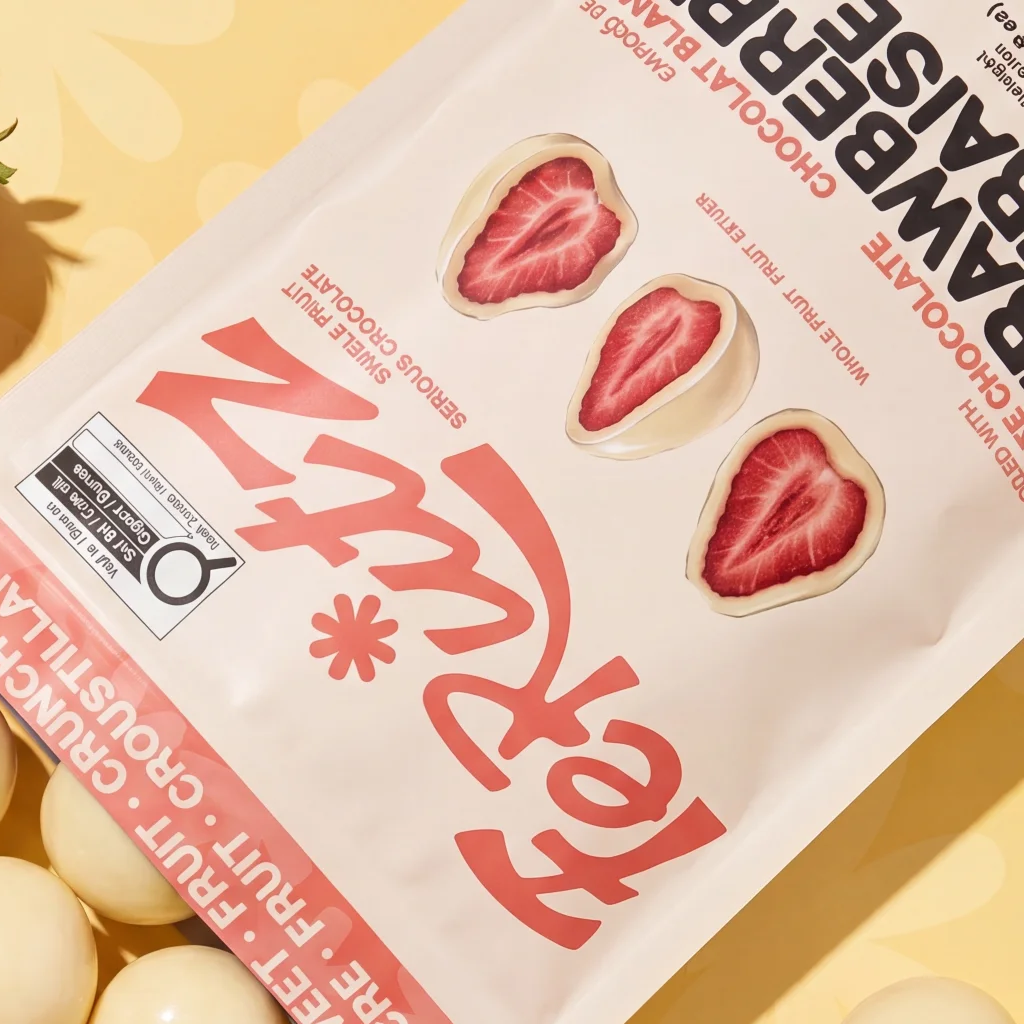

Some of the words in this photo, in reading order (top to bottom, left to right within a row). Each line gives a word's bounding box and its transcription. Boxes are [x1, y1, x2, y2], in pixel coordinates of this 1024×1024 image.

[691, 58, 837, 199] CHOCOLAT
[813, 0, 1024, 262] RAISE
[669, 0, 1024, 390] RAWBERR
[301, 263, 398, 356] CROCOLATE
[819, 327, 870, 386] WHOLE
[861, 231, 1011, 410] CHOCOLATE
[395, 353, 467, 430] SERIOUS
[958, 399, 999, 449] WITH
[134, 815, 247, 930] FRUIT
[212, 831, 325, 949] FRUIT
